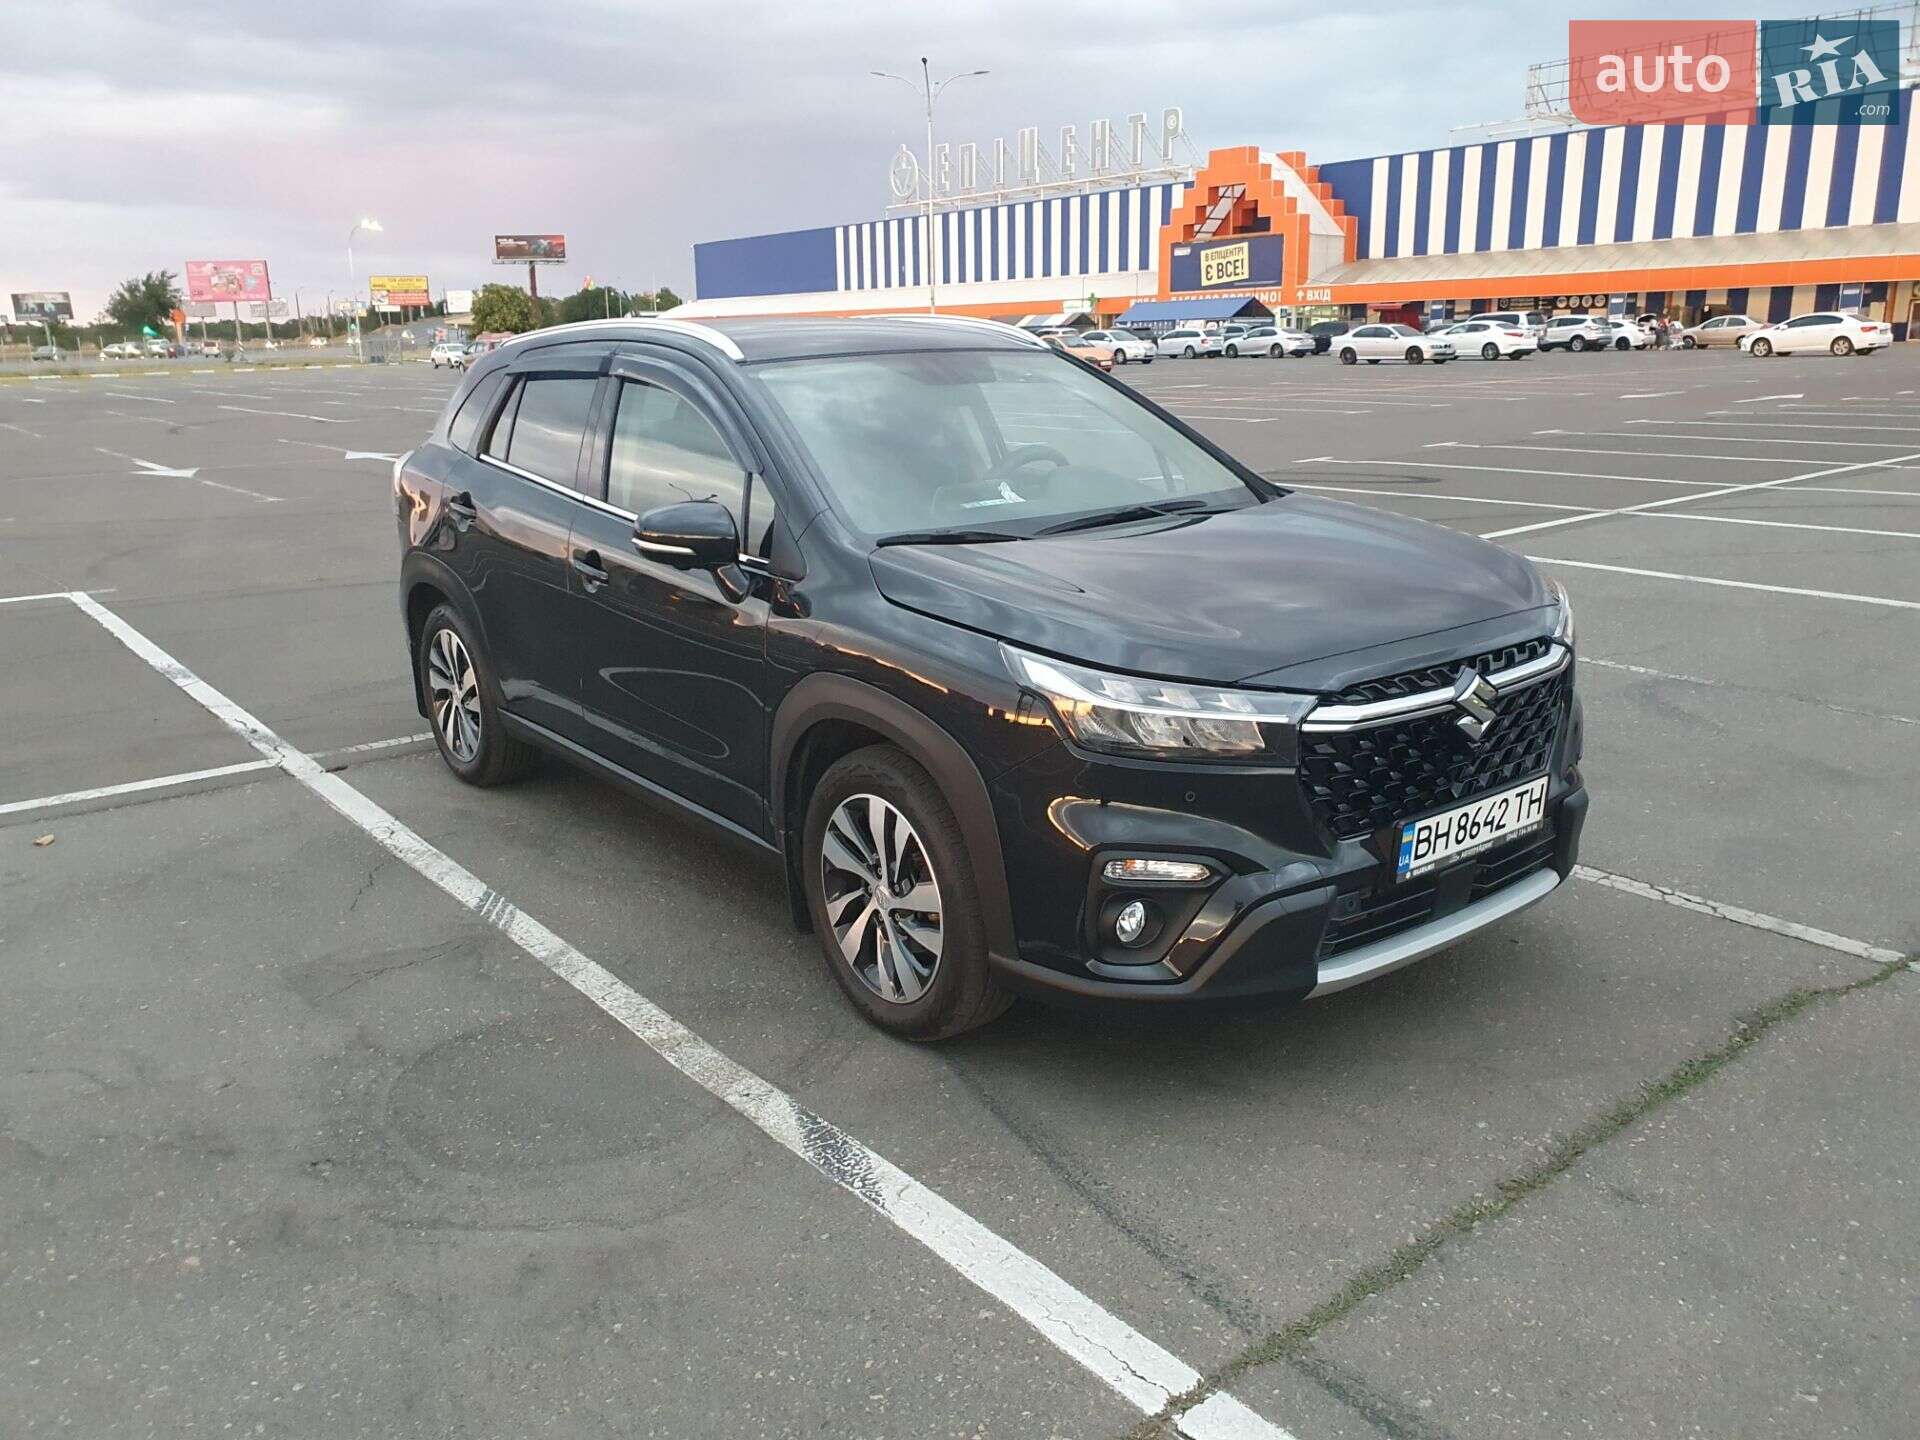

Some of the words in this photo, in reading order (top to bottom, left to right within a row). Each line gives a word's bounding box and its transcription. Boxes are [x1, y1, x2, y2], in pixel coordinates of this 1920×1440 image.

[935, 106, 1182, 192] ЕПІЦЕНТР
[1217, 258, 1244, 279] ВСЕ!
[1306, 289, 1331, 302] ВХІД
[1413, 816, 1453, 861] BH
[1455, 797, 1509, 845] 8642
[1515, 783, 1545, 823] TH
[1399, 855, 1410, 866] UA
